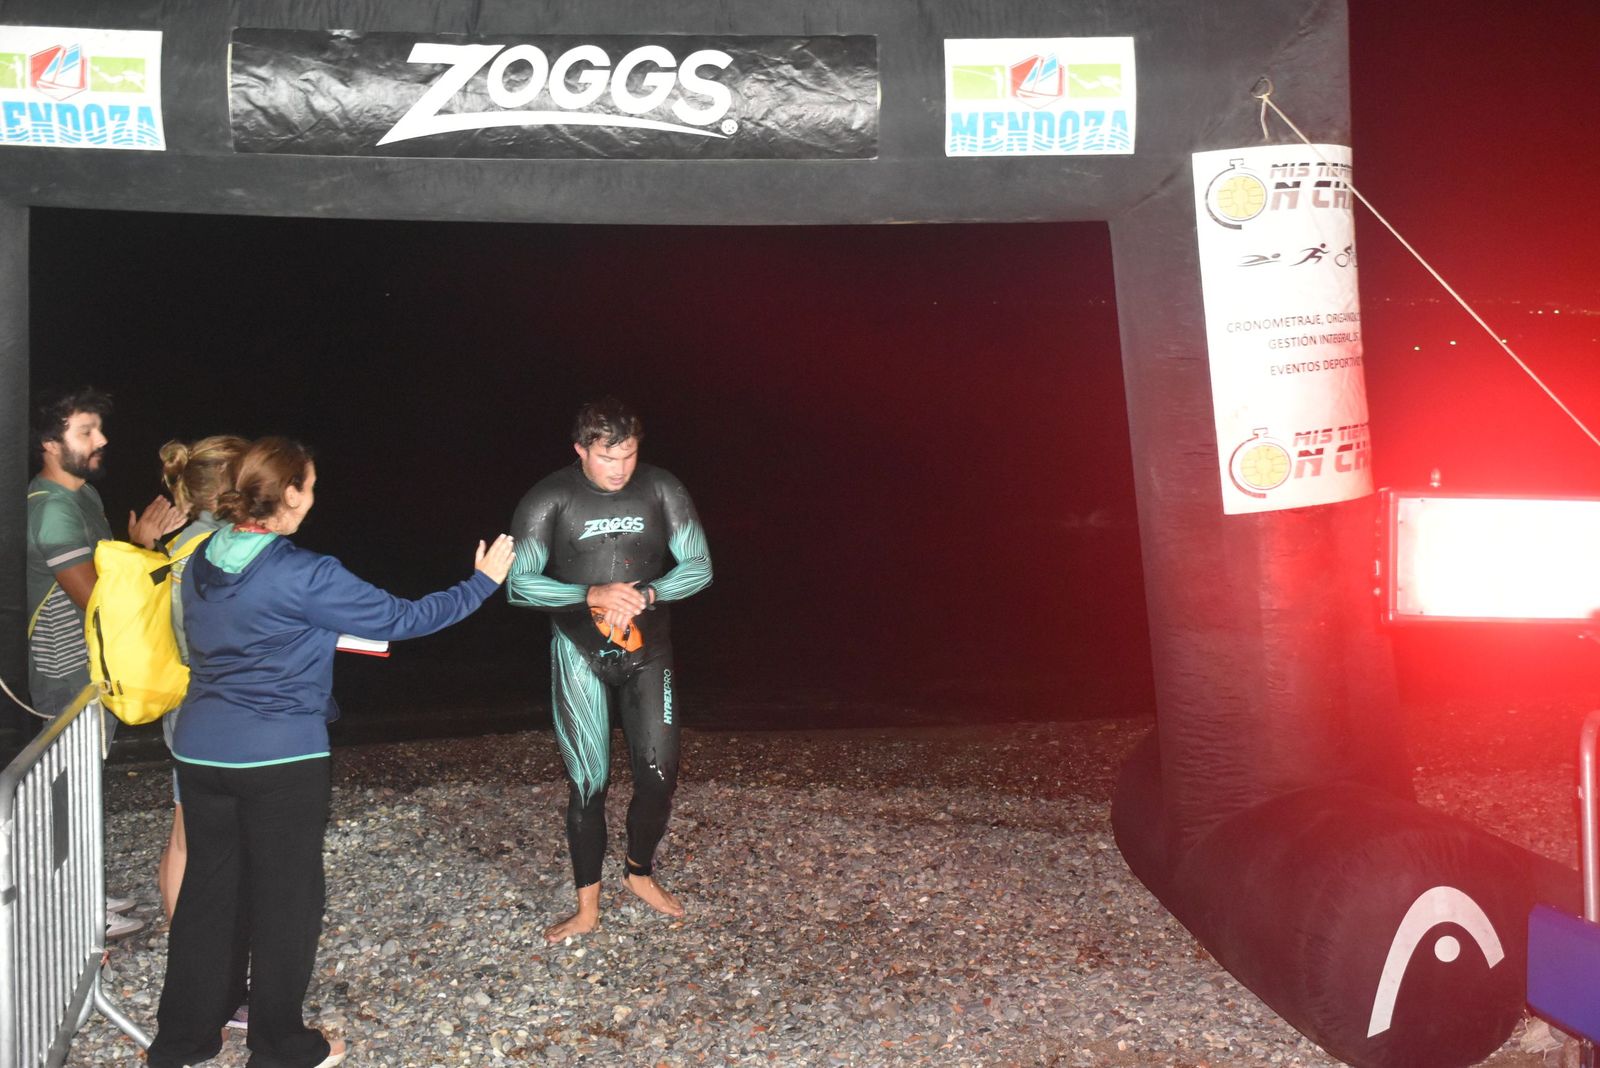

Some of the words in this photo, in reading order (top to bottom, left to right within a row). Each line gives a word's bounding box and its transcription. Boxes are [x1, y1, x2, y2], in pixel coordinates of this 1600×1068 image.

[376, 42, 738, 146] ZOGGS
[0, 101, 161, 146] ENDOZA
[950, 110, 1130, 152] MENDOZA
[1270, 163, 1310, 178] MIS
[1226, 314, 1324, 333] CRONOMETRAJE,
[1268, 332, 1317, 349] GESTIÓN
[1270, 360, 1320, 376] EVENTOS
[1293, 427, 1333, 447] MIS
[578, 516, 645, 540] ZOGGS
